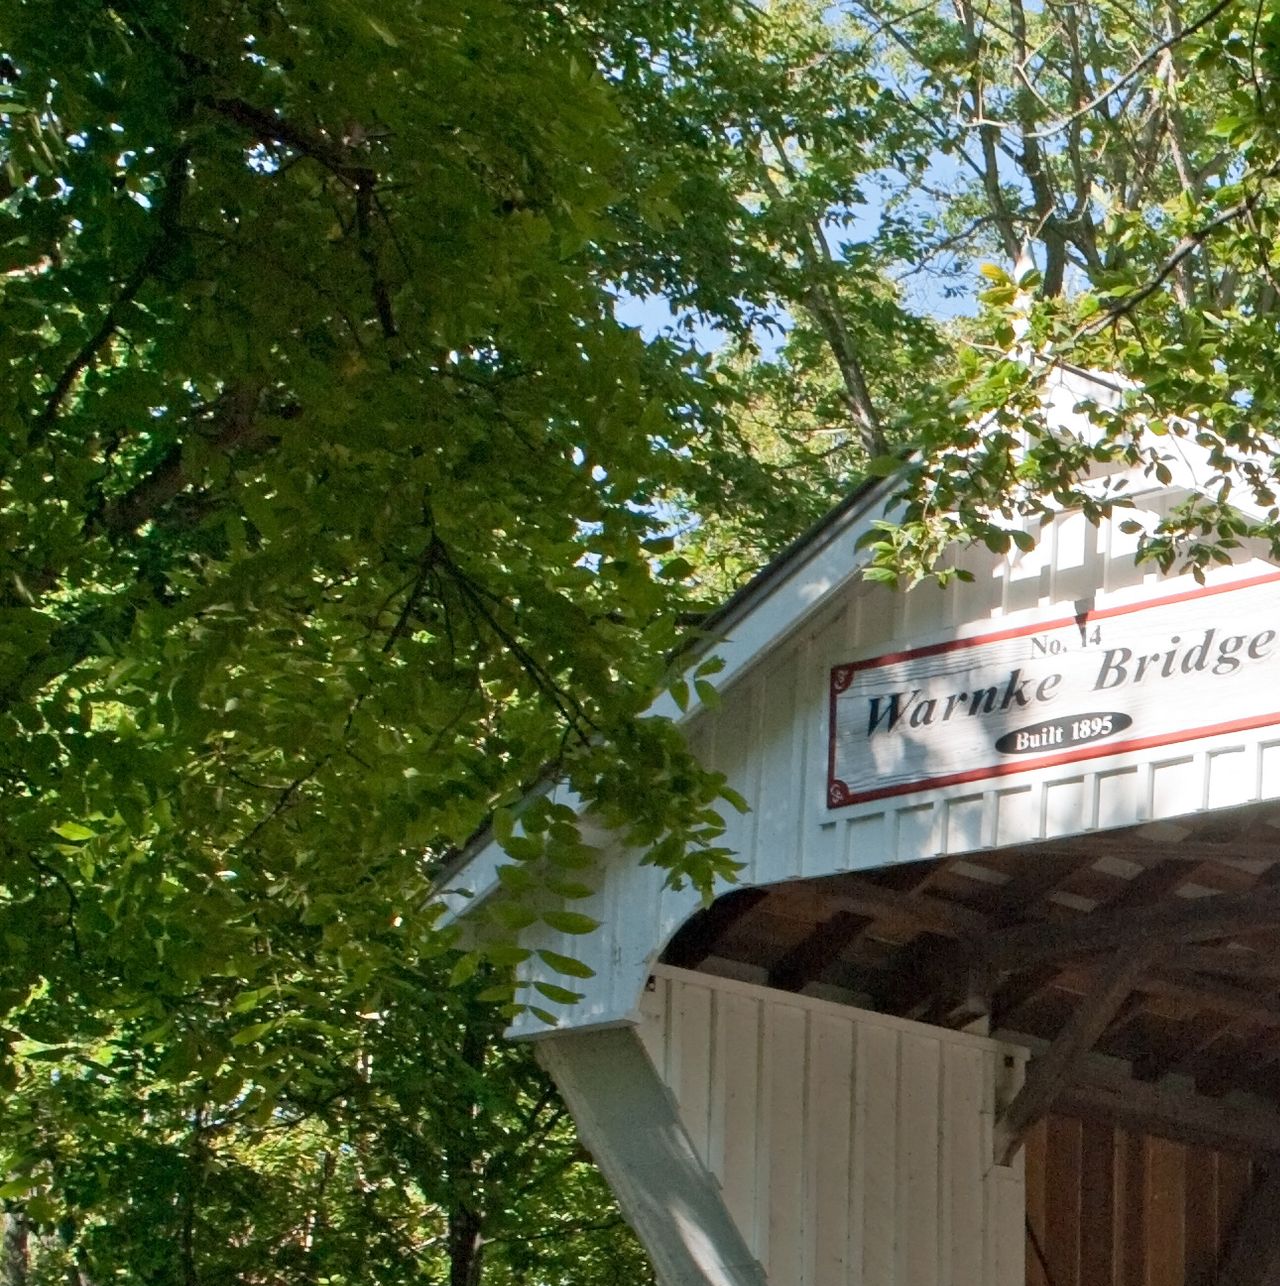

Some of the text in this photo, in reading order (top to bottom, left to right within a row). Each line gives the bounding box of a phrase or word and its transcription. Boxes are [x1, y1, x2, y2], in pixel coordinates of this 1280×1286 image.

[1030, 635, 1067, 659] No.
[867, 629, 1276, 737] Warnke Bridge
[1015, 715, 1113, 751] Built 1895
